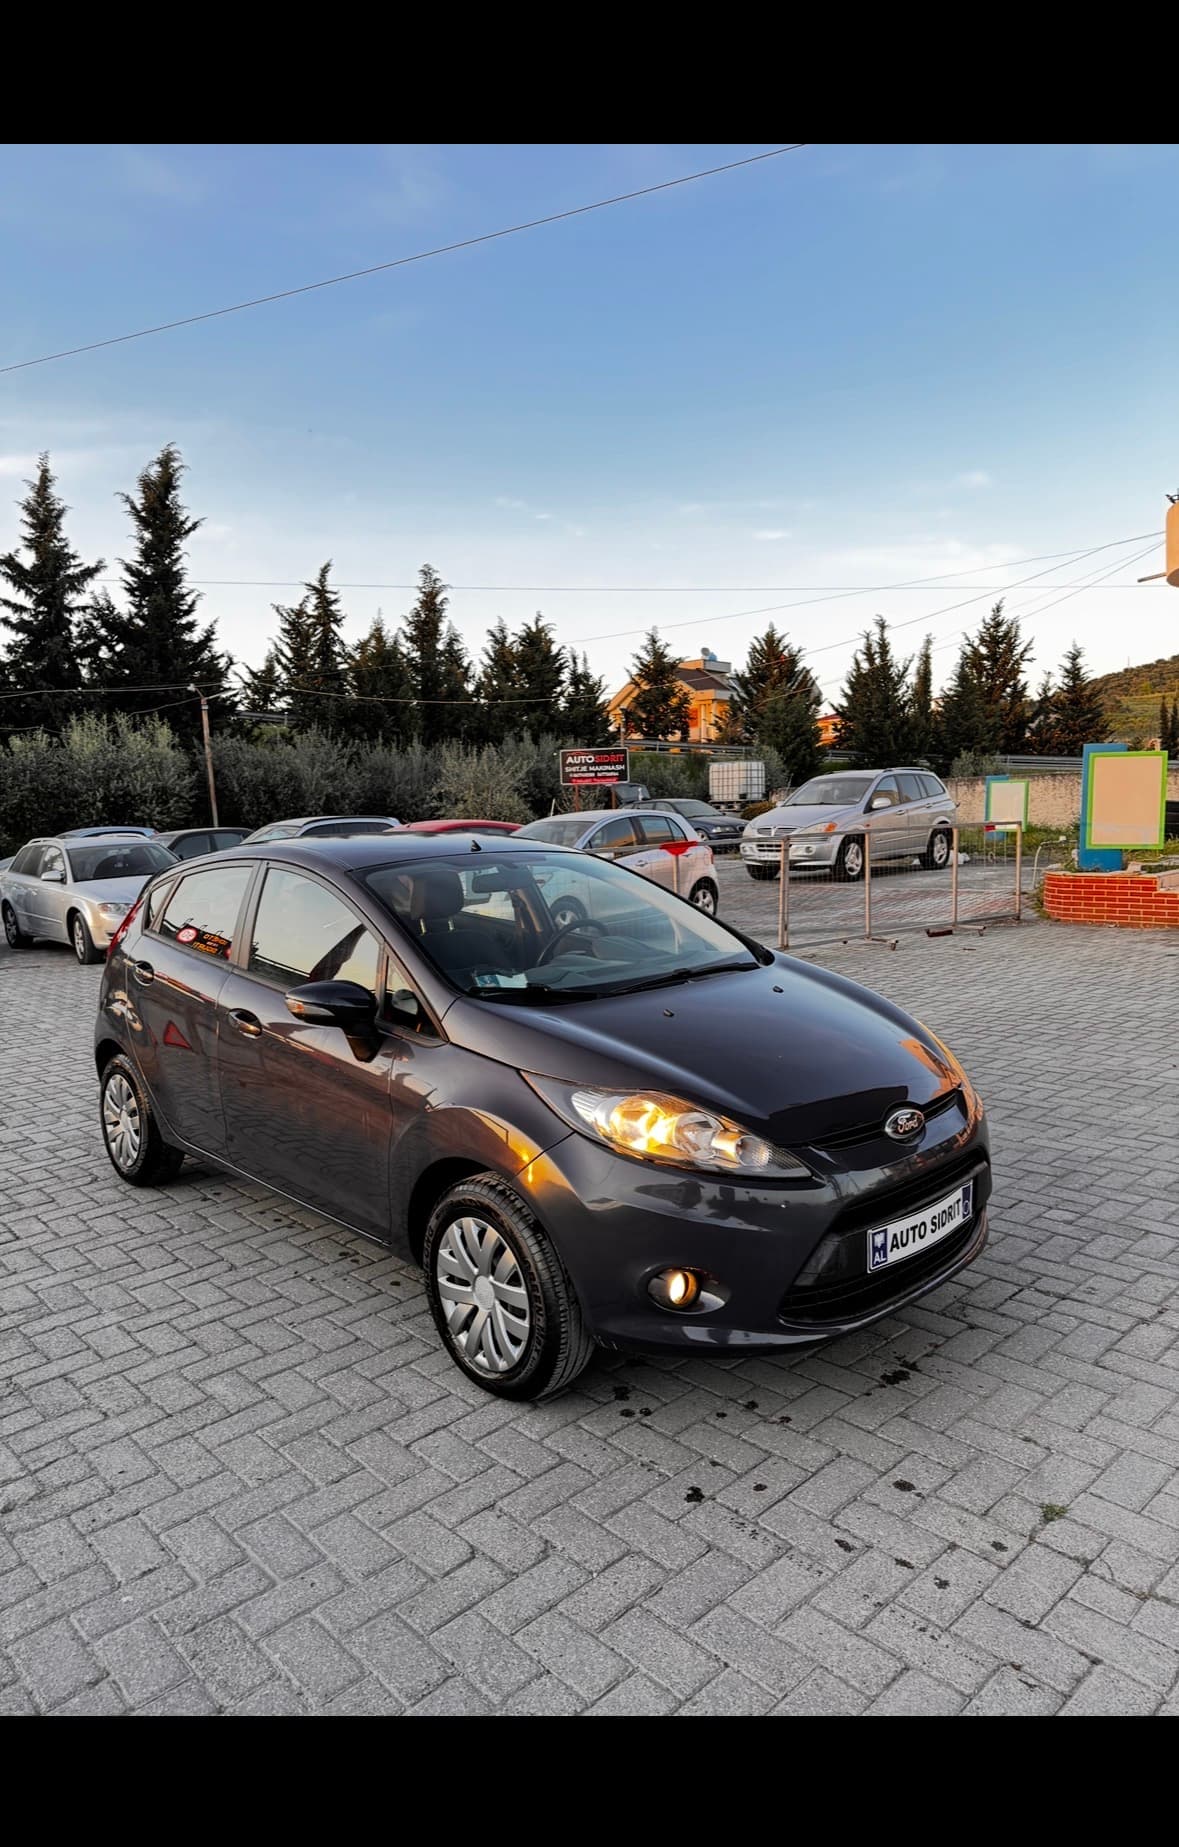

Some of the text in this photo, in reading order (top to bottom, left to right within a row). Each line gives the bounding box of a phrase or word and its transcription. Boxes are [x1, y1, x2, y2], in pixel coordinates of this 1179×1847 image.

[897, 1112, 919, 1133] Ford
[890, 1199, 961, 1252] AUTO SIDRIT
[873, 1250, 886, 1265] AL
